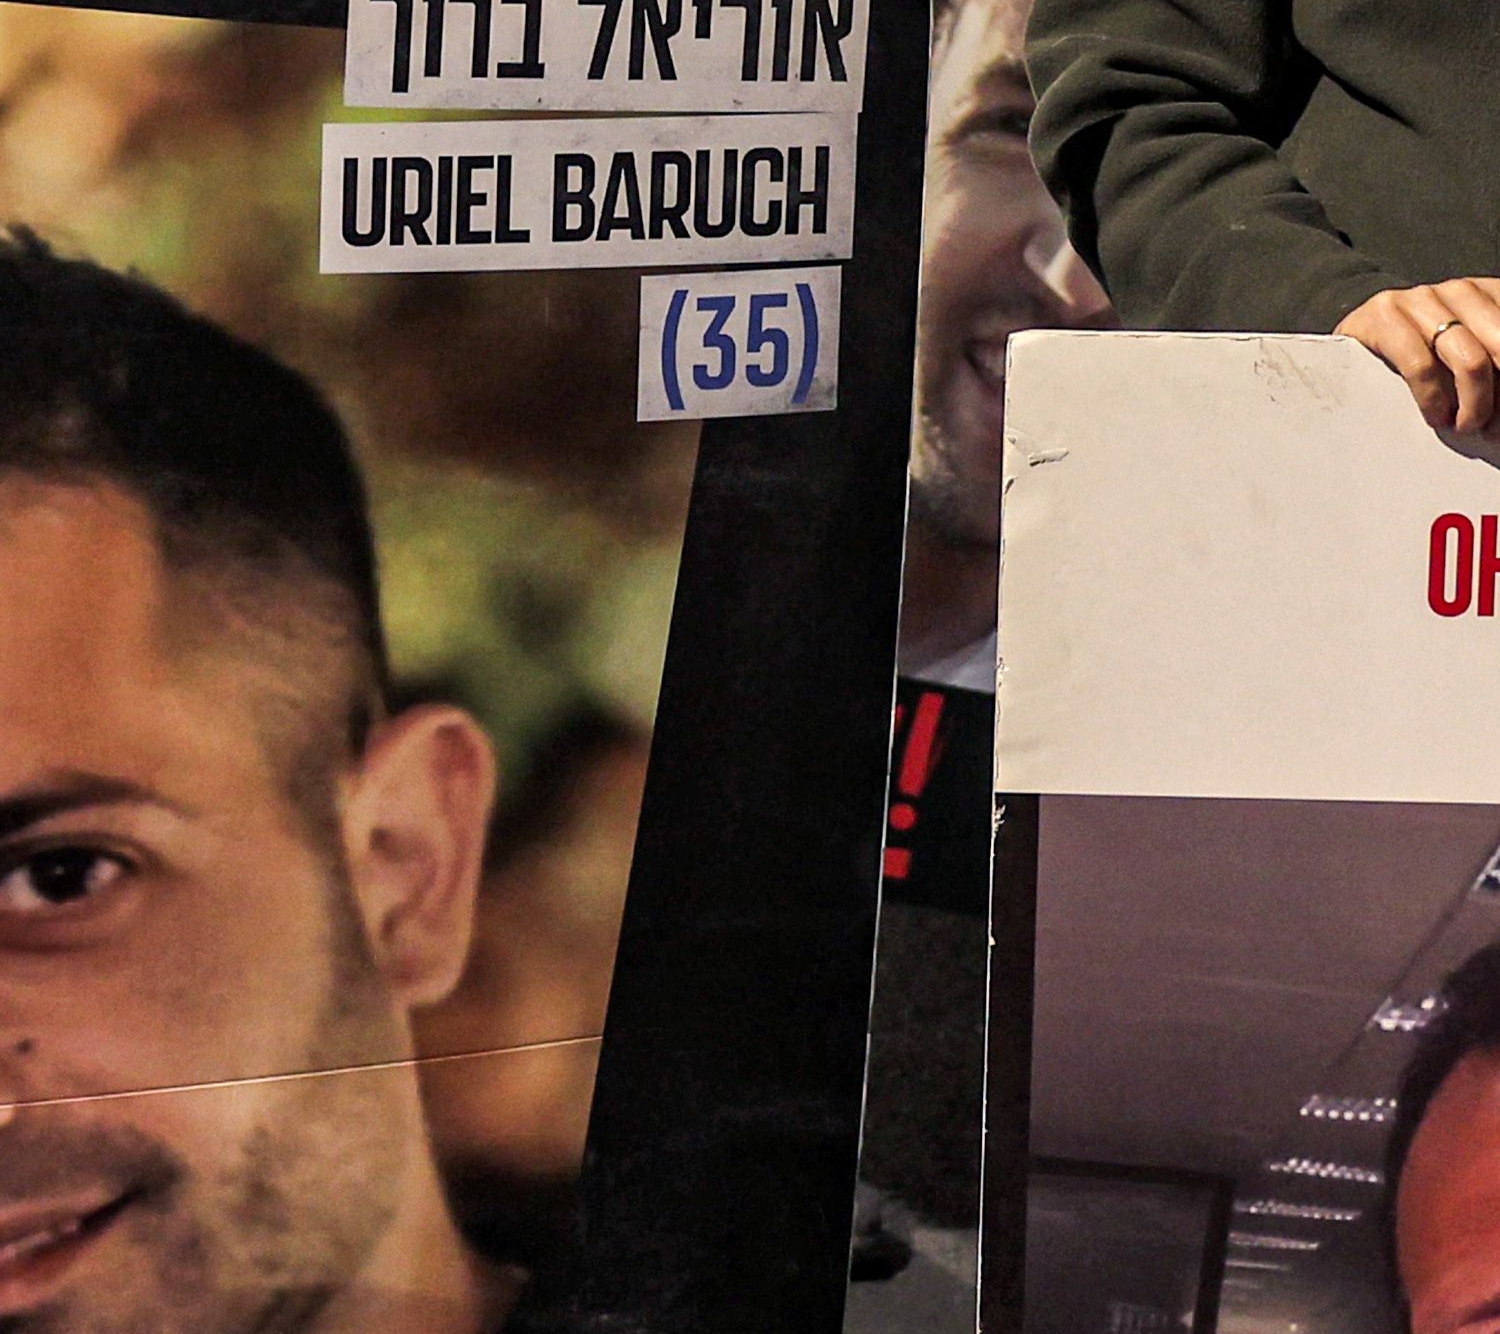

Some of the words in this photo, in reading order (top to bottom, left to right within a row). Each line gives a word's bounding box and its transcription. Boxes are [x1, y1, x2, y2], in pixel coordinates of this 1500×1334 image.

[341, 153, 532, 249] URIEL
[552, 144, 831, 242] BARUCH
[661, 282, 821, 412] (35)
